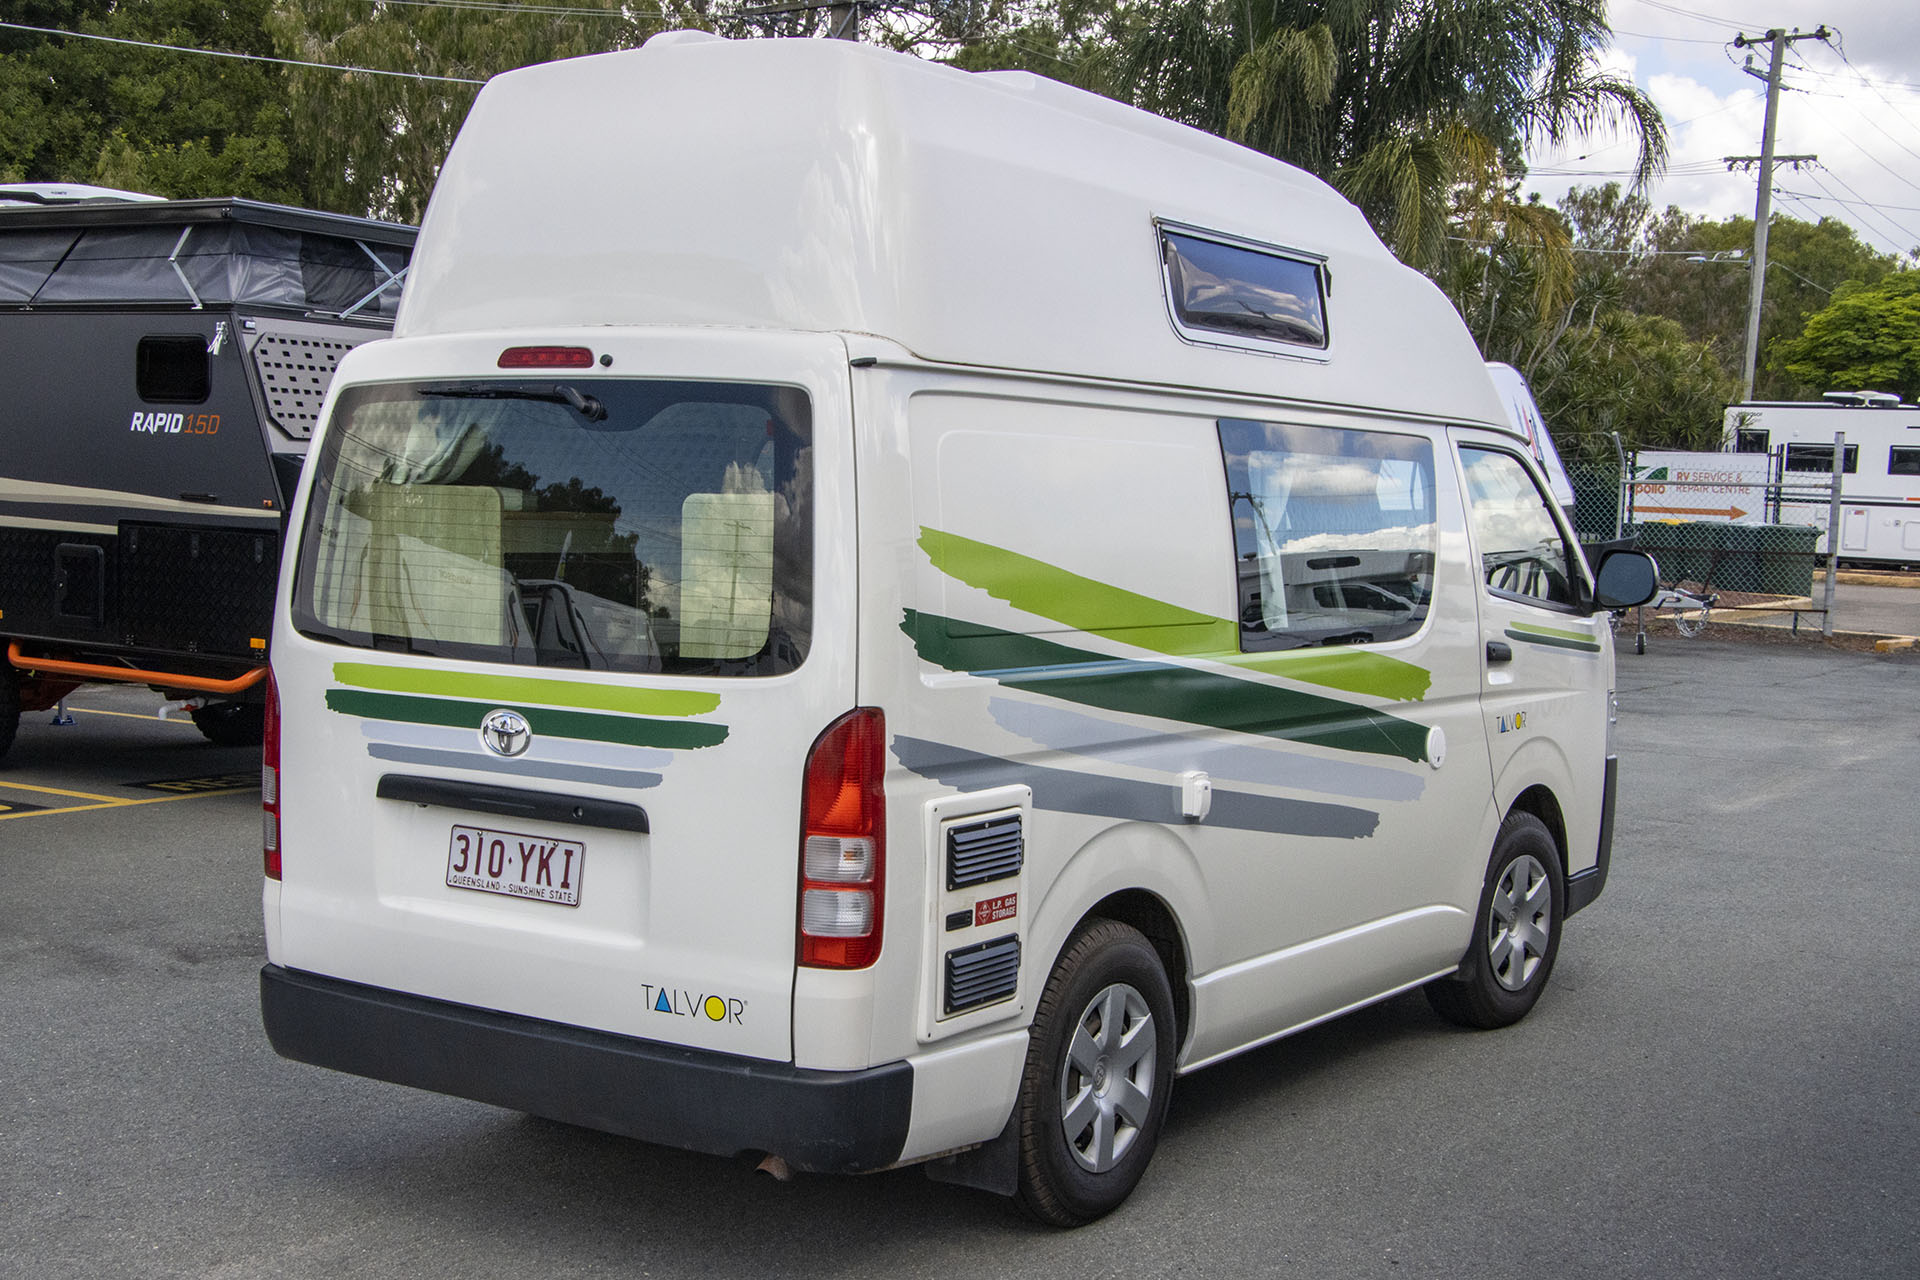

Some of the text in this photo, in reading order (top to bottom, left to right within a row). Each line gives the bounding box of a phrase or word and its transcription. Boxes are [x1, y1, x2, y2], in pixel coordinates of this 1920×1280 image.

[129, 412, 184, 435] RAPID
[1676, 471, 1743, 483] RV SERVICE &
[1628, 483, 1666, 496] pollo
[1676, 485, 1751, 495] REPAIR CENTRE
[1496, 711, 1527, 734] TALVOR
[453, 875, 572, 902] QUEENSLAND SUNSHINE STATE
[1005, 896, 1016, 907] GAS
[992, 906, 1016, 920] STORAGE
[641, 984, 744, 1025] TALVOR
